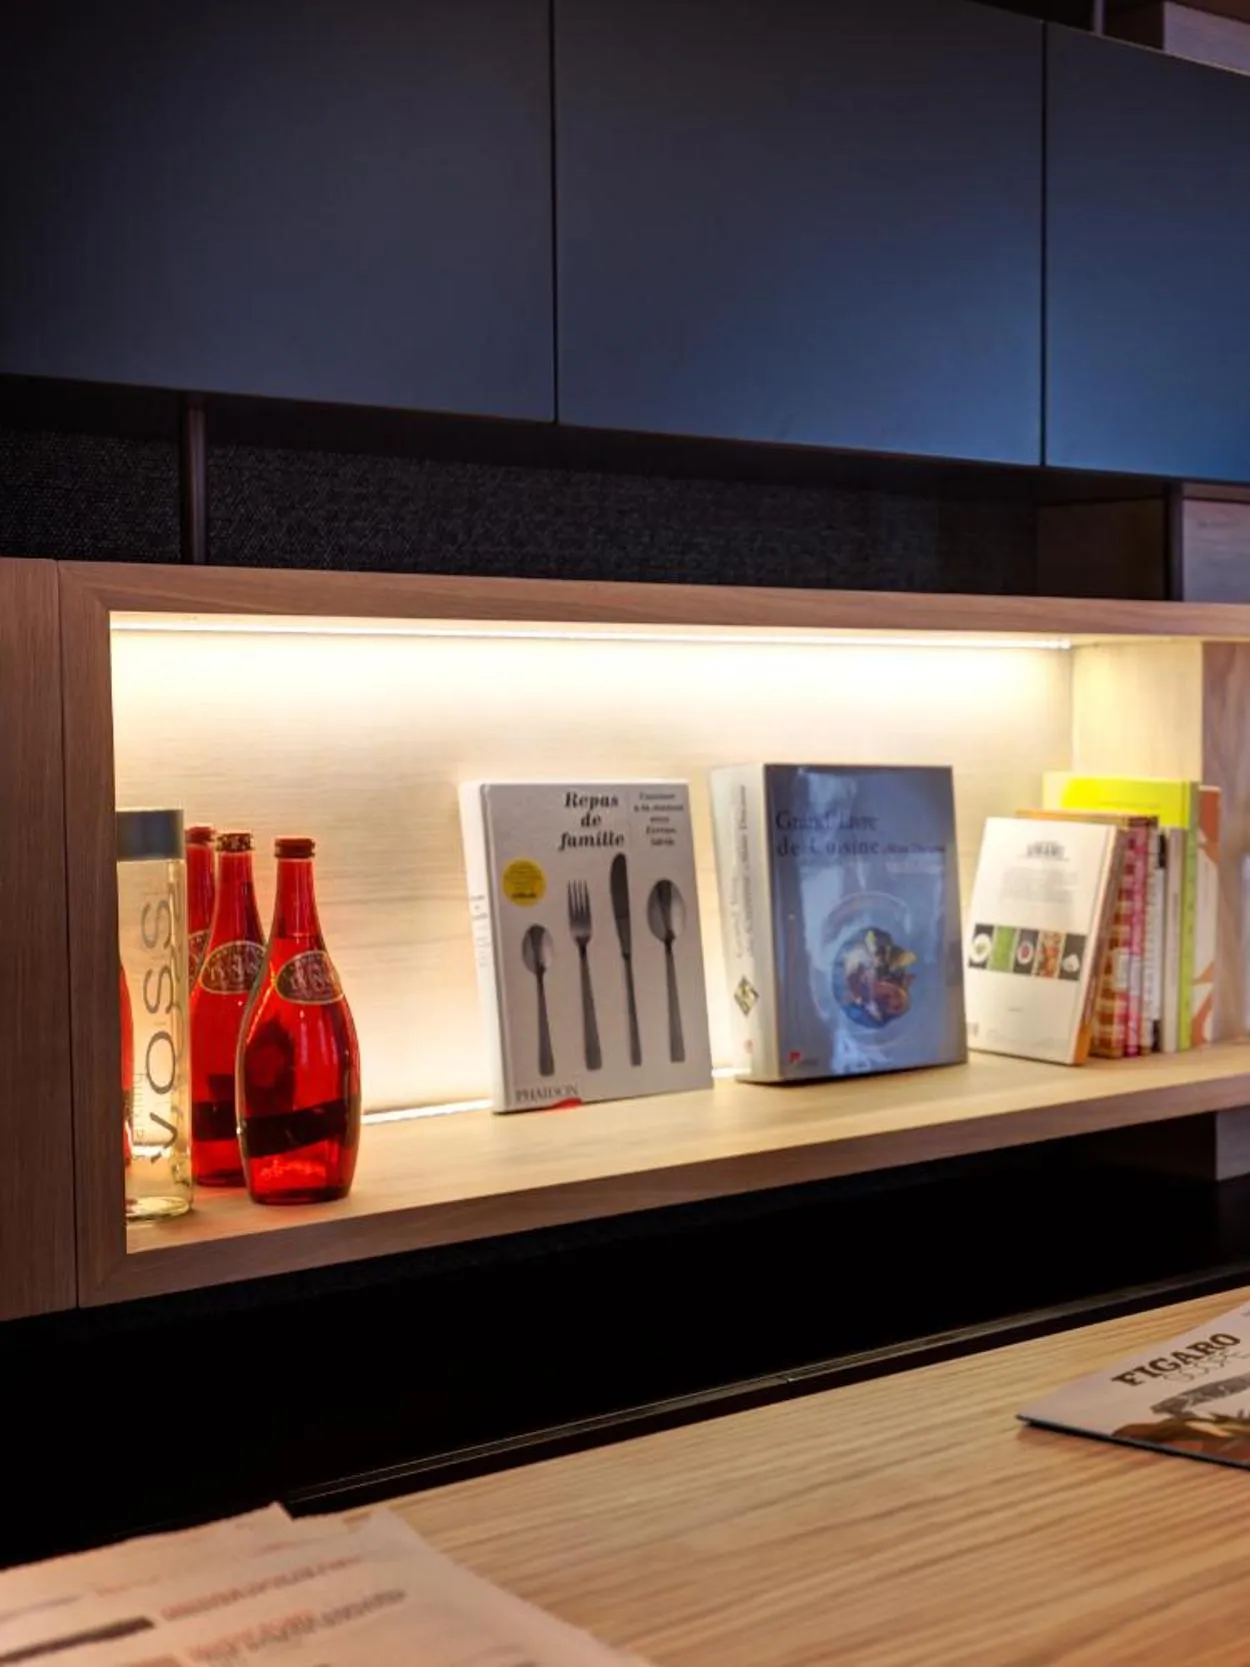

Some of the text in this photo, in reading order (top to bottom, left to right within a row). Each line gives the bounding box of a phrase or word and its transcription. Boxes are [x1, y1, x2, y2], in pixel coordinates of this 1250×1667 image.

[564, 791, 619, 811] Repas
[581, 812, 602, 827] de
[558, 830, 625, 852] famille
[141, 900, 178, 1163] VOSS
[1111, 1332, 1241, 1387] FIGARO
